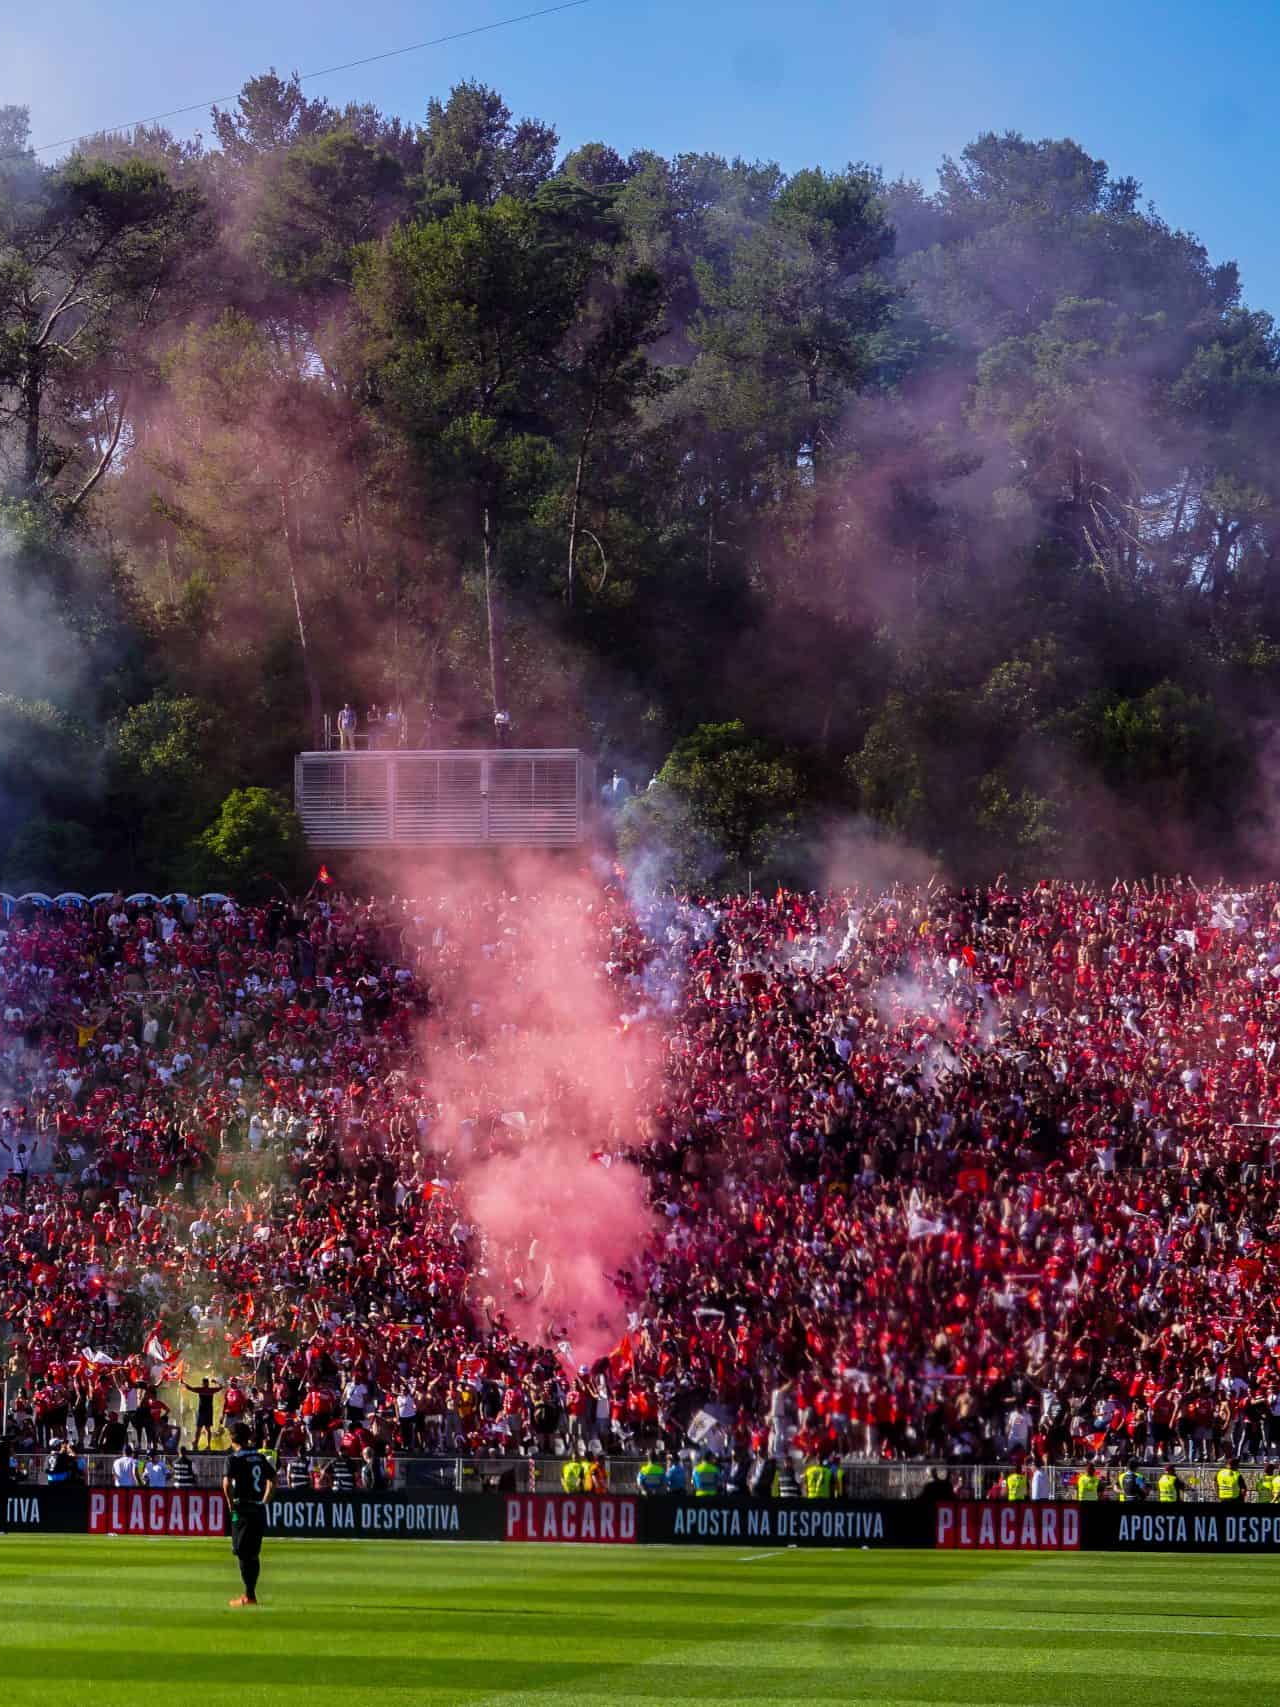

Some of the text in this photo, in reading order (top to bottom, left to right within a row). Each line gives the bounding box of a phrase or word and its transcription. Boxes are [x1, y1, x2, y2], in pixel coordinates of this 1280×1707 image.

[91, 1494, 224, 1531] PLACARD
[332, 1503, 355, 1529] NA
[362, 1504, 459, 1530] DESPORTIVA
[507, 1500, 635, 1538] PLACARD
[674, 1508, 883, 1538] APOSTA NA DESPORTIVA
[937, 1508, 1079, 1545] PLACARD
[1119, 1515, 1186, 1541] APOSTA
[1195, 1516, 1218, 1542] NA
